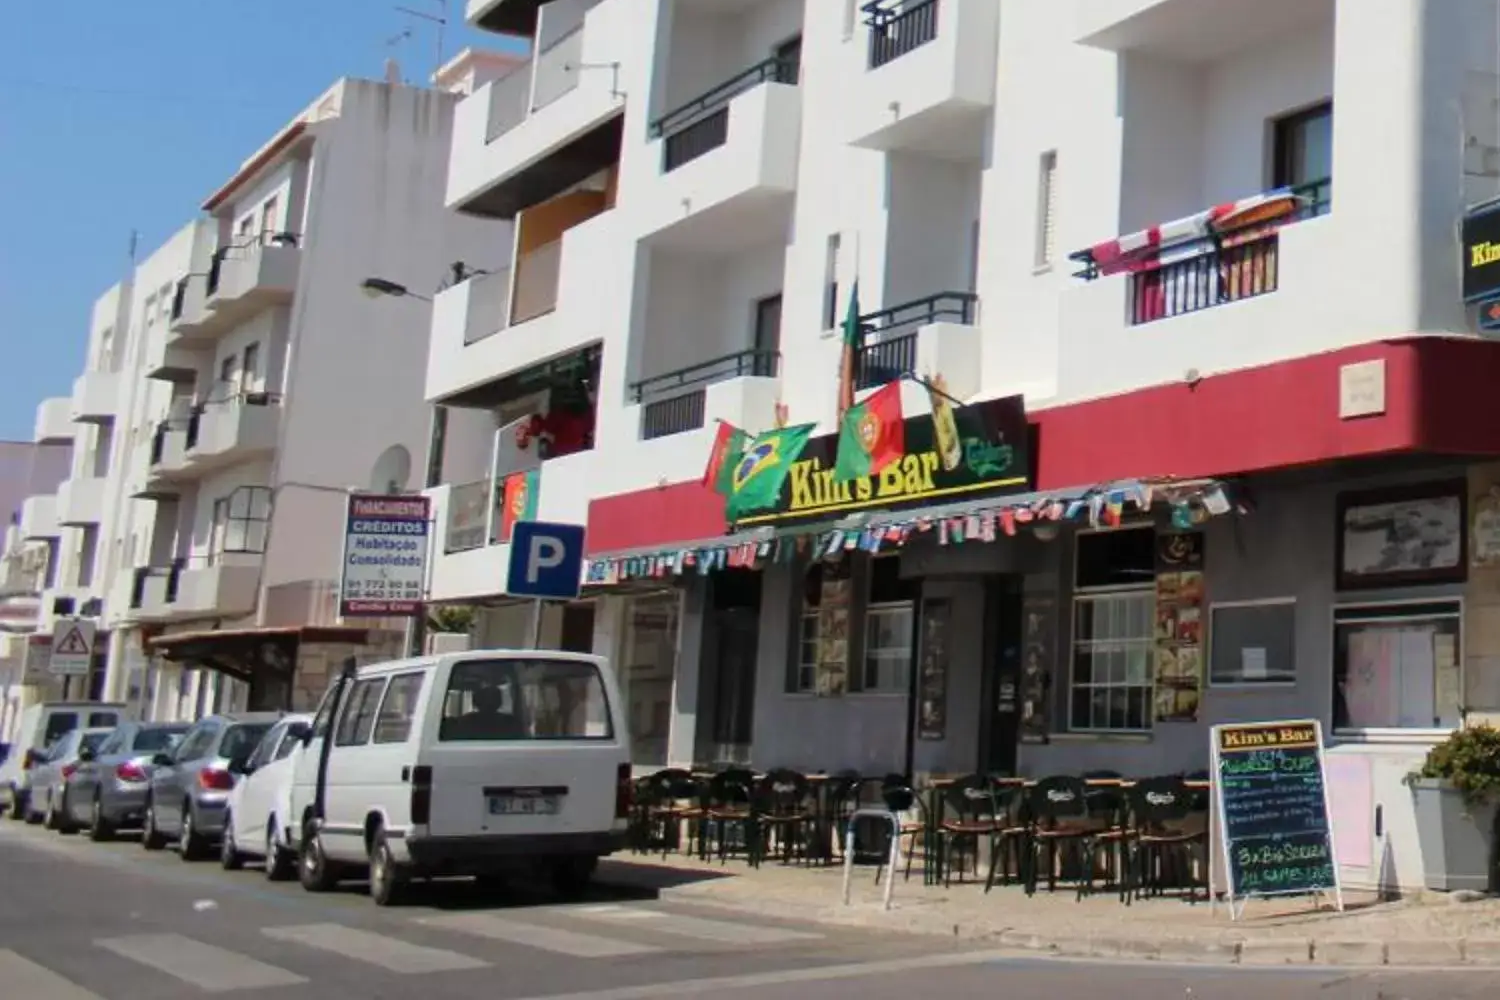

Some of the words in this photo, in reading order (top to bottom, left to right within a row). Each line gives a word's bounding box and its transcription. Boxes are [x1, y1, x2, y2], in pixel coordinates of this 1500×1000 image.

[353, 520, 425, 532] CRÉDITOS
[355, 537, 417, 551] Habitação
[527, 535, 566, 584] P
[1224, 730, 1277, 746] Kim's
[1280, 727, 1314, 741] Bar
